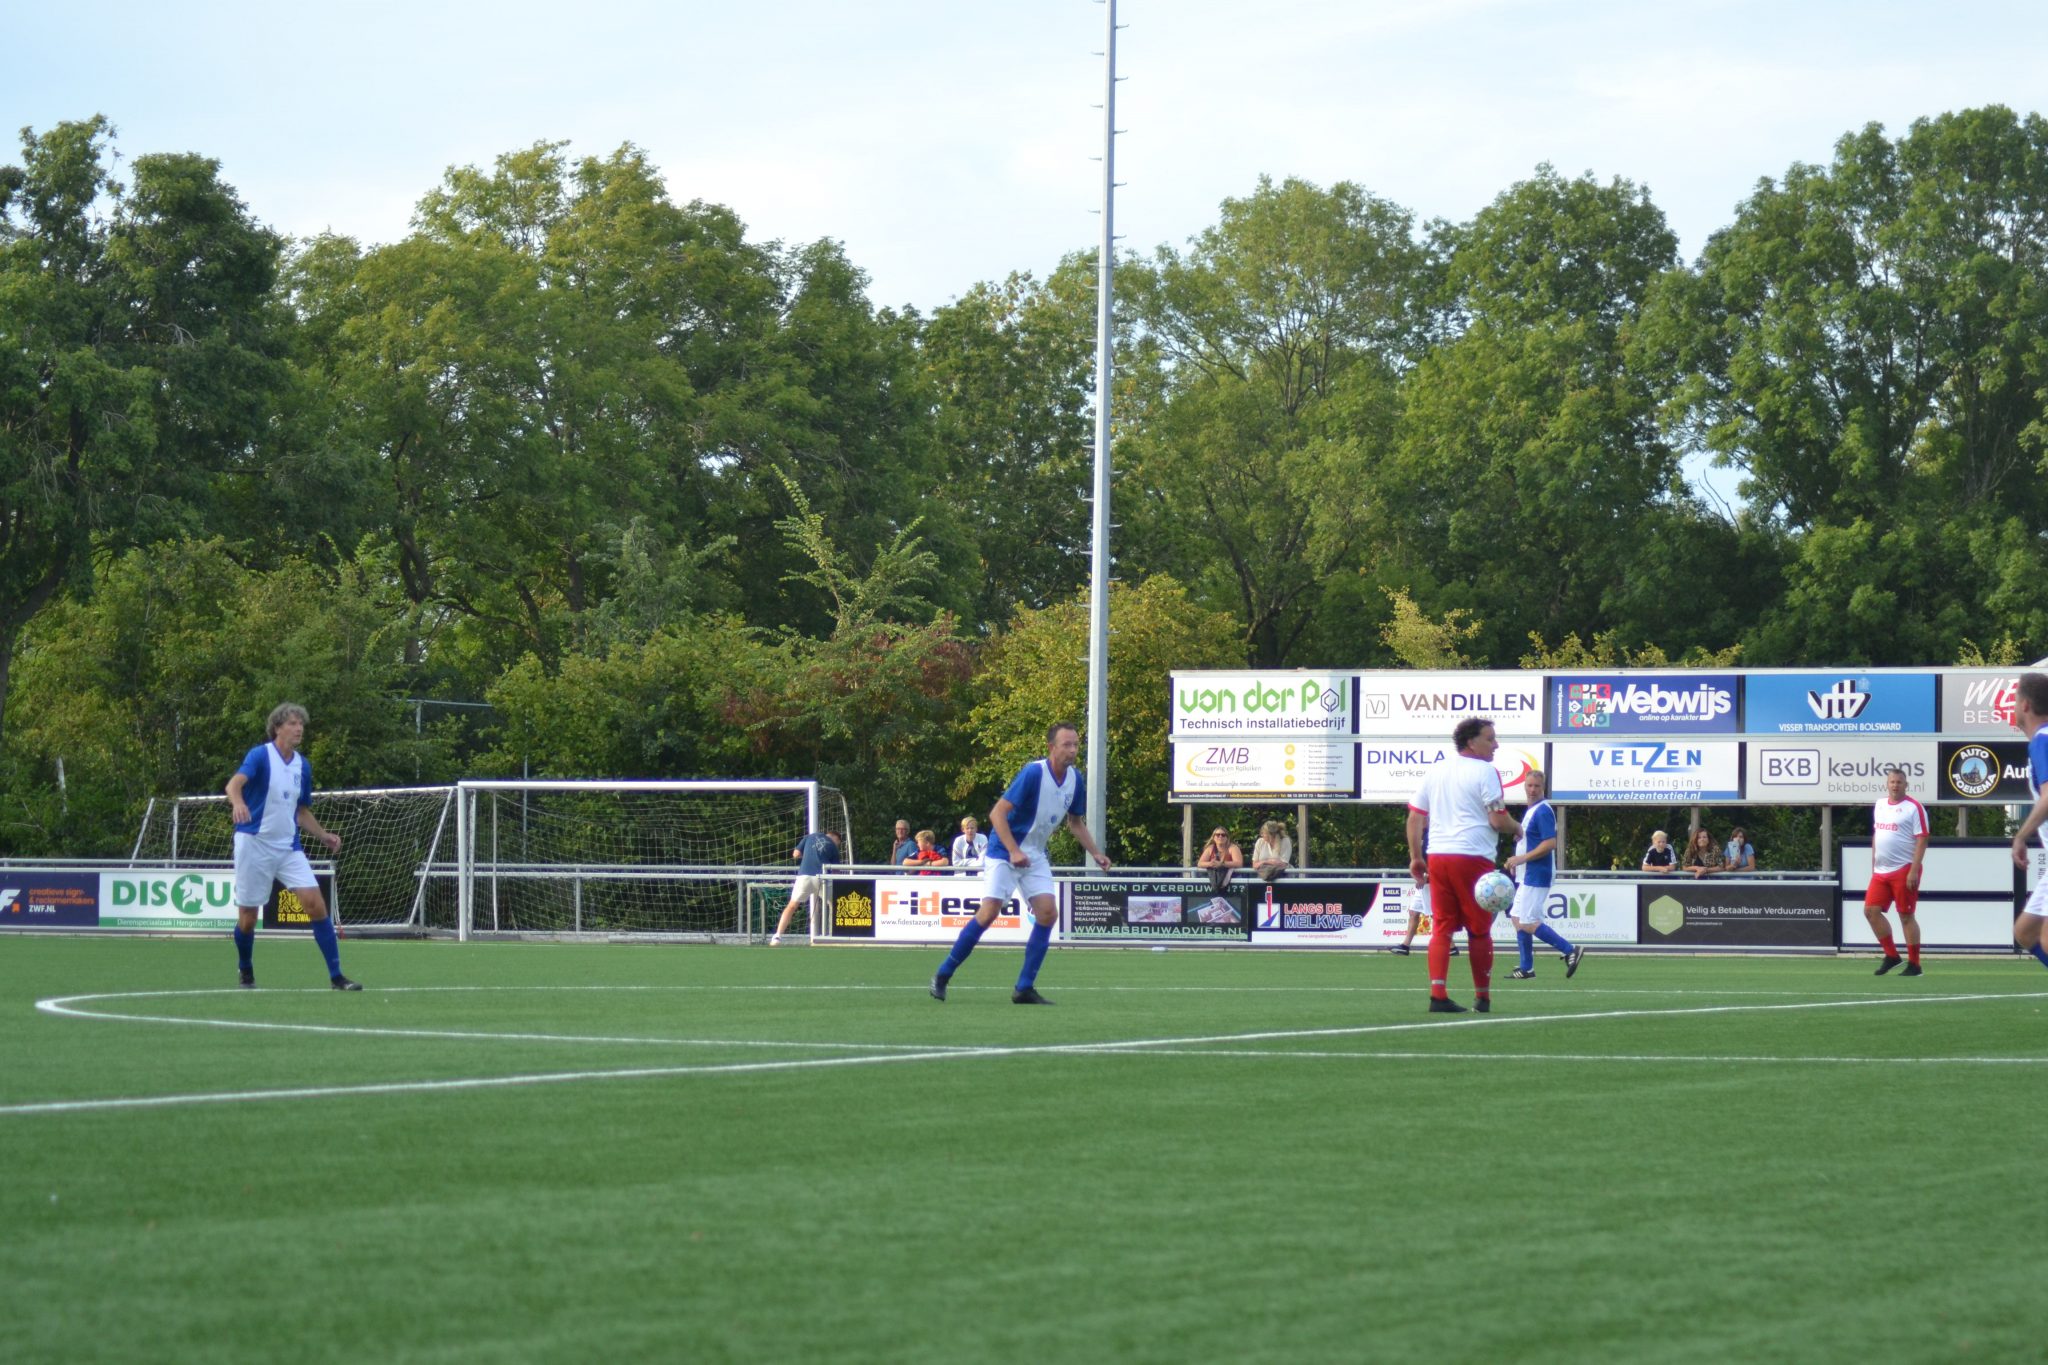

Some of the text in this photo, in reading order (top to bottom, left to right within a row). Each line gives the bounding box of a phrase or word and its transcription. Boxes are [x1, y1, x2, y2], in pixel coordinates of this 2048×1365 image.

[1180, 679, 1346, 714] van der Pol
[1964, 678, 2019, 707] WIE
[1400, 694, 1536, 711] VANDILLEN
[1964, 710, 2015, 723] BEST
[1180, 717, 1346, 730] Technisch installatiebedrijf
[1779, 722, 1901, 732] VISSER TRANSPORTEN BOLSWARD
[1206, 747, 1250, 764] ZMB
[1590, 743, 1702, 773] VELZEN
[1960, 749, 1989, 760] AUTO
[1194, 765, 1225, 773] Zonwering
[1769, 758, 1811, 777] BKB
[2003, 764, 2030, 779] Aut
[1590, 778, 1702, 789] textielreiniging
[1952, 773, 1996, 794] FOEKEMA
[1588, 792, 1701, 800] www.velzentextiel.nl
[113, 875, 237, 915] DISCU
[881, 891, 1020, 915] F-idesa
[1284, 903, 1342, 914] LANGS DE
[1686, 906, 1709, 915] Veilig
[1718, 906, 1762, 914] Betaalbaar
[1763, 907, 1825, 915] Verduurzamen
[117, 919, 172, 927] Dierenspeciaalzaak
[176, 919, 213, 927] Hengelsport
[278, 914, 311, 922] SC BOLSWA
[836, 918, 872, 926] SC BOLSWARD
[881, 919, 939, 927] www.fidestazorg.nl
[1284, 915, 1363, 929] MELKWEG
[1074, 926, 1244, 935] WWW.BGBOUWADVIES.NL
